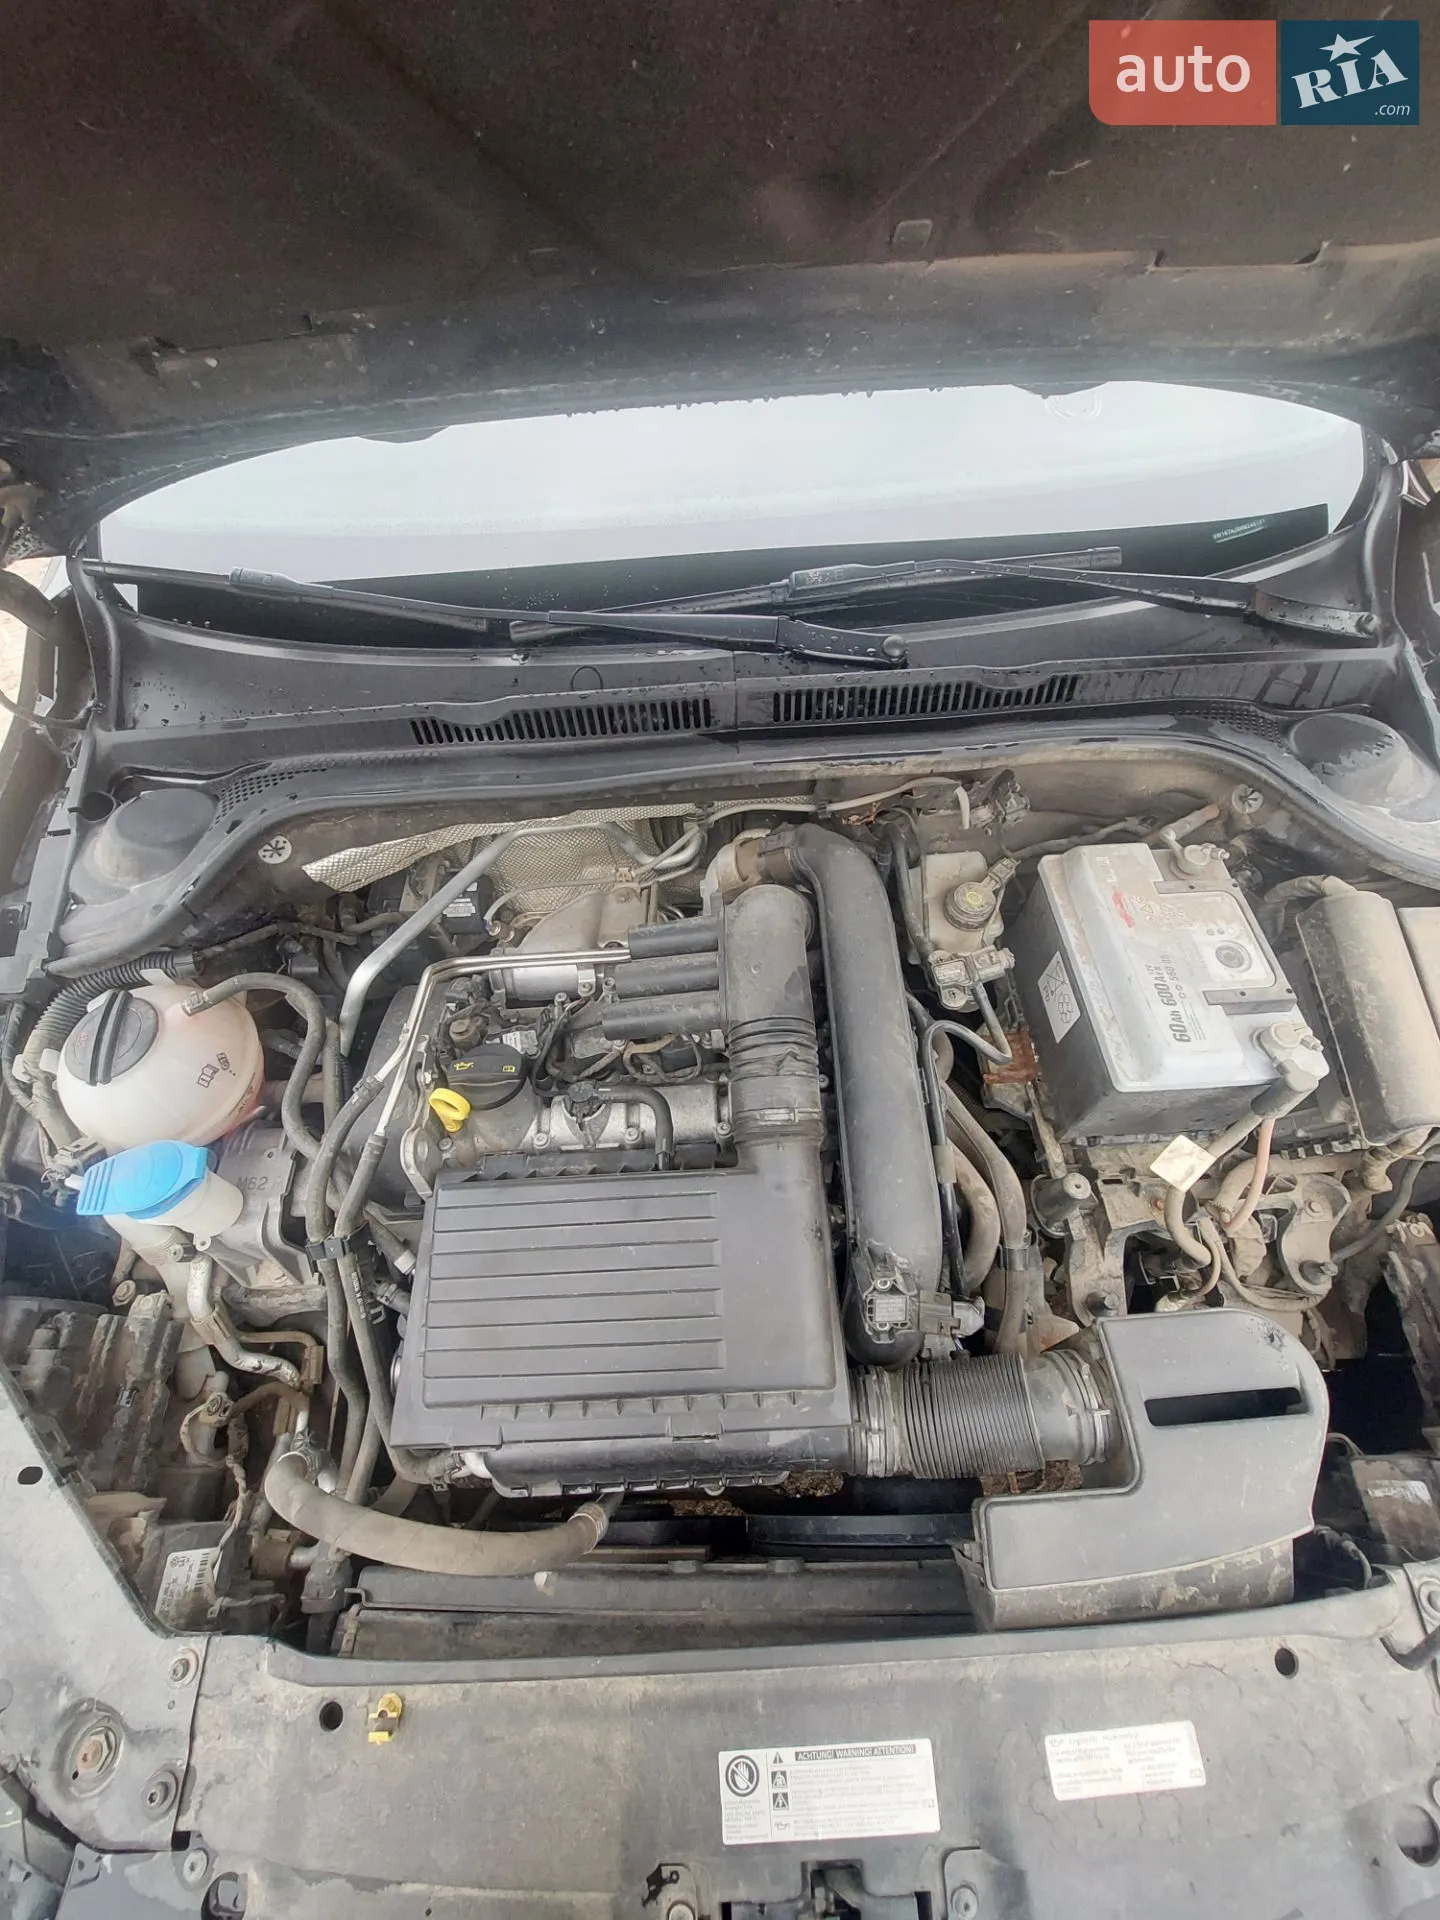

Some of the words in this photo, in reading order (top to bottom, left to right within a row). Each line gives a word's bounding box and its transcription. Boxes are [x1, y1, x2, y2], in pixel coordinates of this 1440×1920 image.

[1169, 1010, 1192, 1043] 60Ah
[797, 1751, 834, 1761] ACHTUNG!
[835, 1748, 873, 1758] WARNING!
[873, 1745, 915, 1756] ATTENTION!
